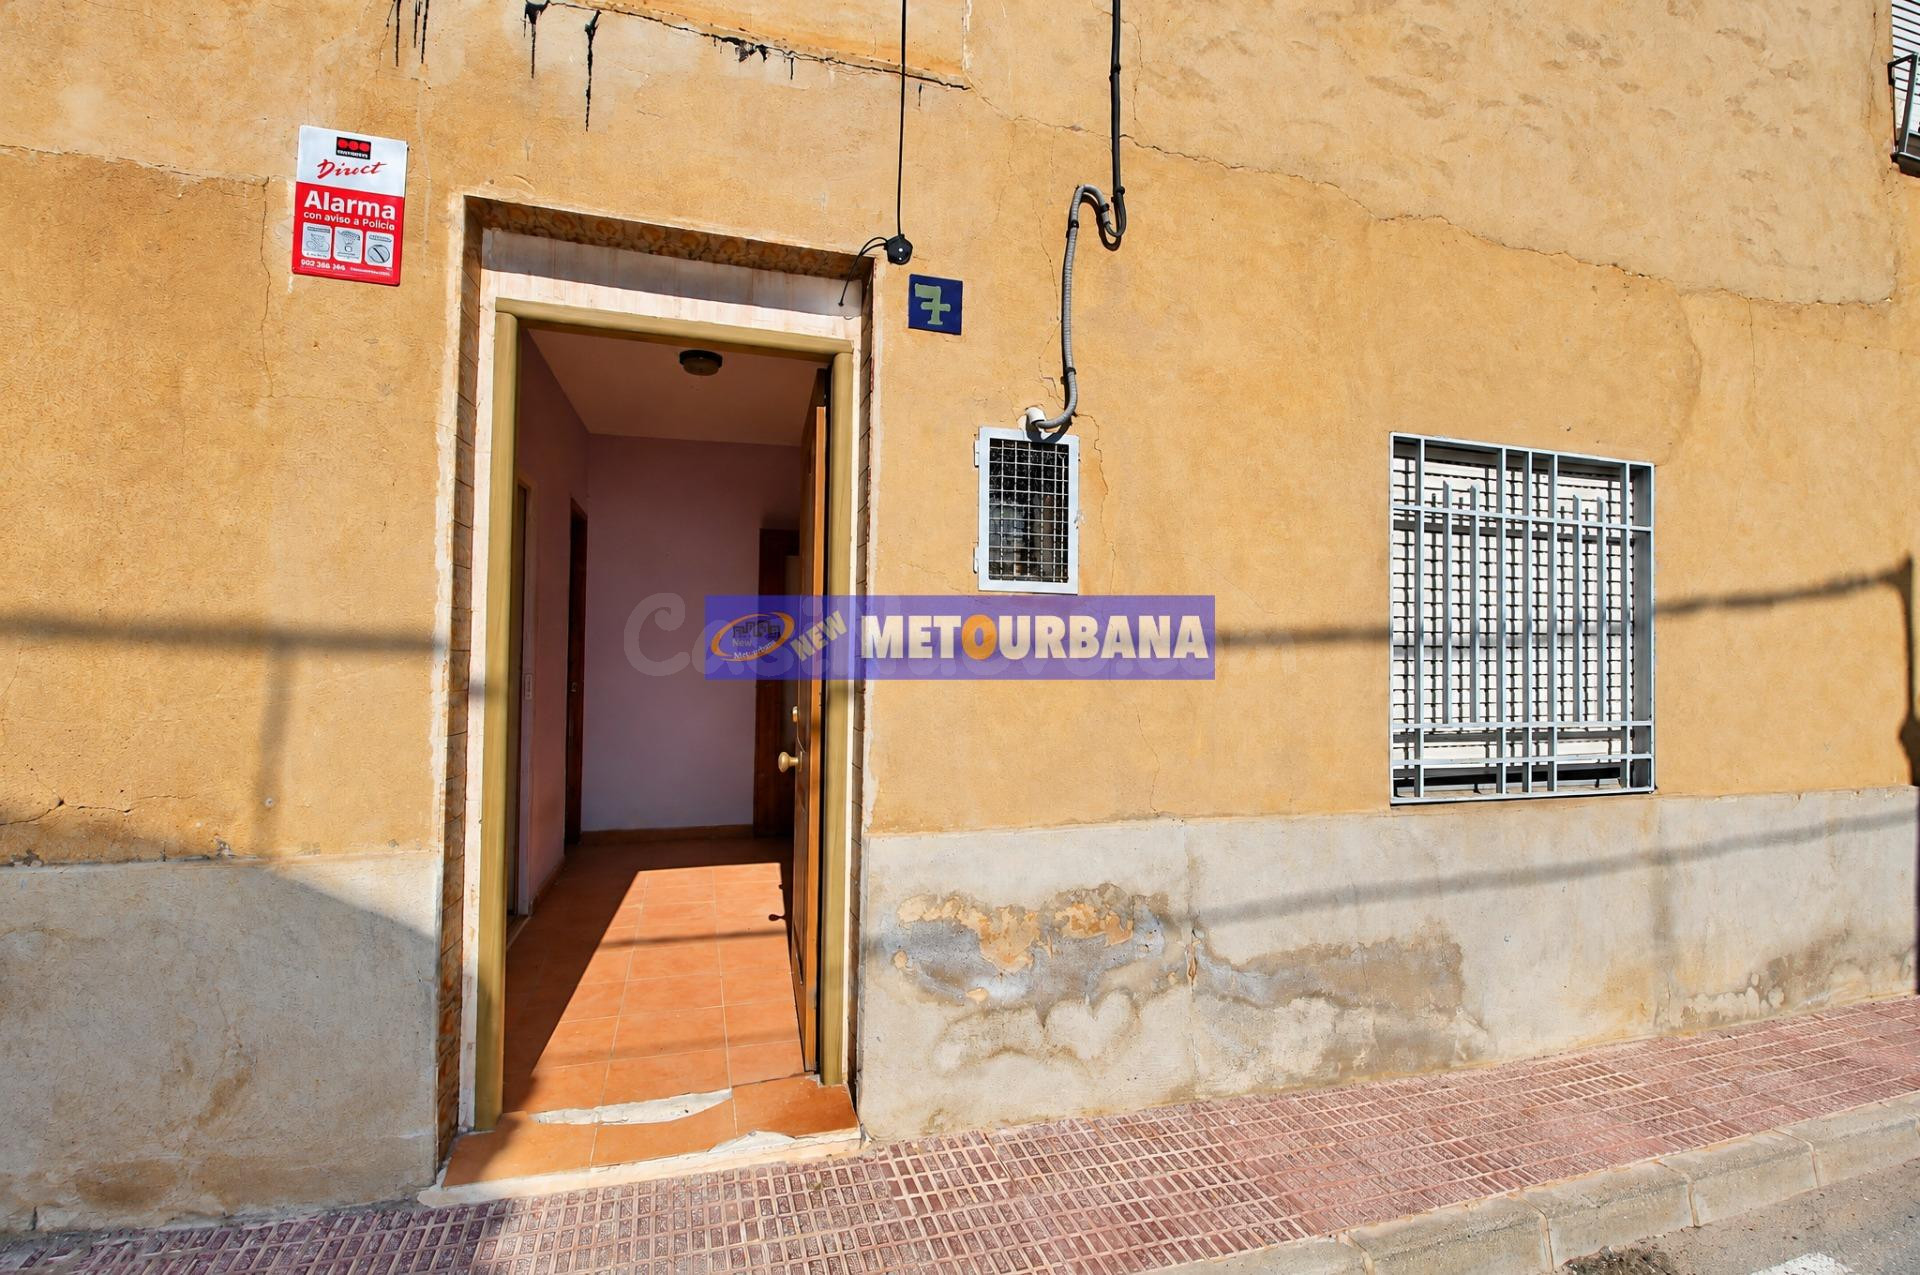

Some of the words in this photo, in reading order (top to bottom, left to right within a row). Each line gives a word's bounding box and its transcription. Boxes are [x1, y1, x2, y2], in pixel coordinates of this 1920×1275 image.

[303, 211, 322, 221] con
[324, 213, 351, 224] aviso
[353, 218, 359, 226] a
[304, 190, 396, 220] Alarma
[914, 283, 951, 325] 7
